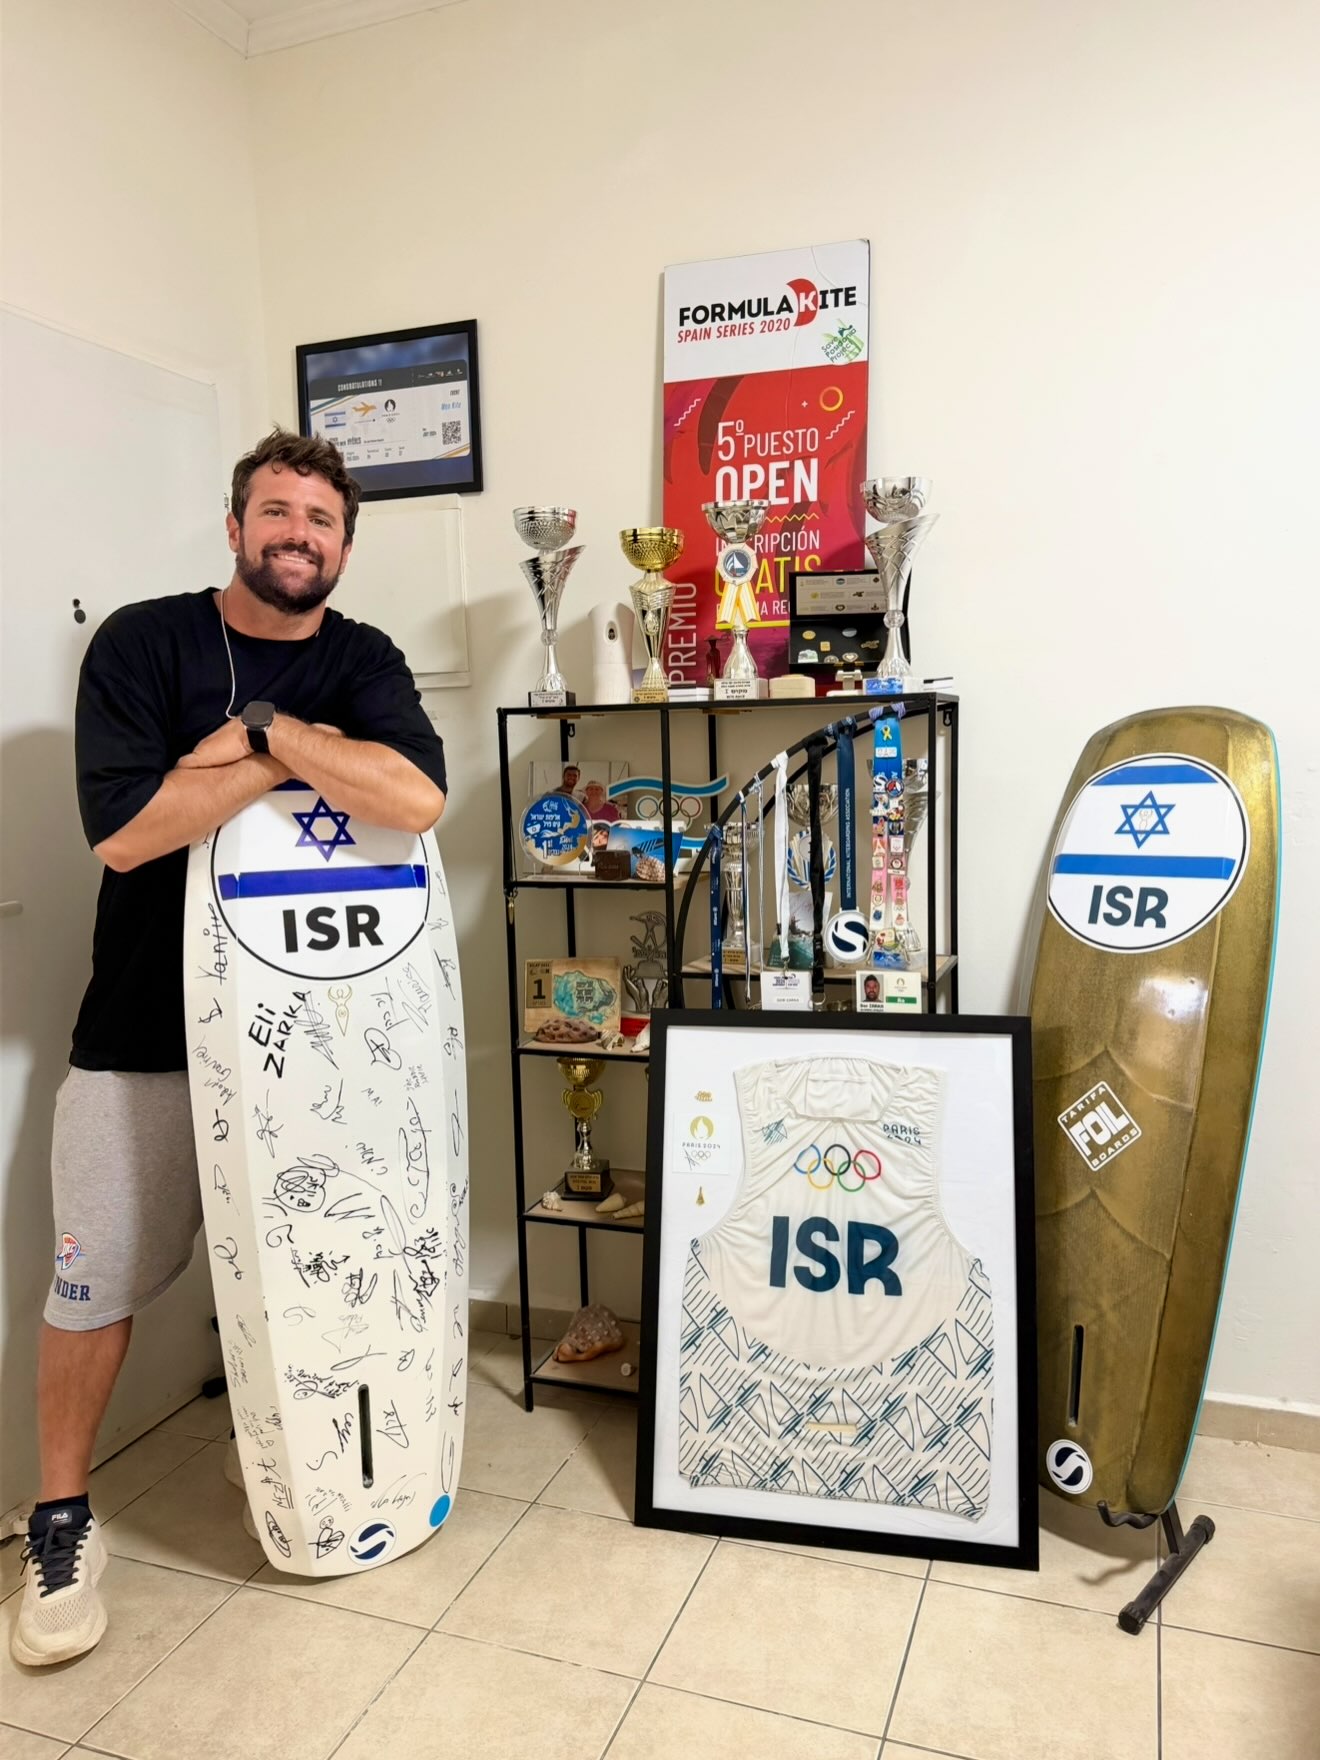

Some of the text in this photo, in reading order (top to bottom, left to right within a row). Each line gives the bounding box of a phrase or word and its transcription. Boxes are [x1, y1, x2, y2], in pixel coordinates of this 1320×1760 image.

[677, 317, 791, 344] SPAIN SERIES 2020
[744, 428, 819, 458] PUESTO
[715, 458, 819, 505] OPEN
[1087, 884, 1169, 929] ISR
[282, 904, 384, 953] ISR
[533, 979, 546, 1000] 1
[248, 1002, 276, 1047] Eli
[263, 990, 312, 1079] ZARKA
[1061, 1086, 1106, 1123] TARIFA
[883, 1123, 921, 1136] PARIS
[1069, 1101, 1130, 1157] FOIL
[1091, 1128, 1138, 1167] BOARDS
[769, 1215, 903, 1297] ISR
[54, 1274, 91, 1302] NDER
[51, 1512, 68, 1521] FILA
